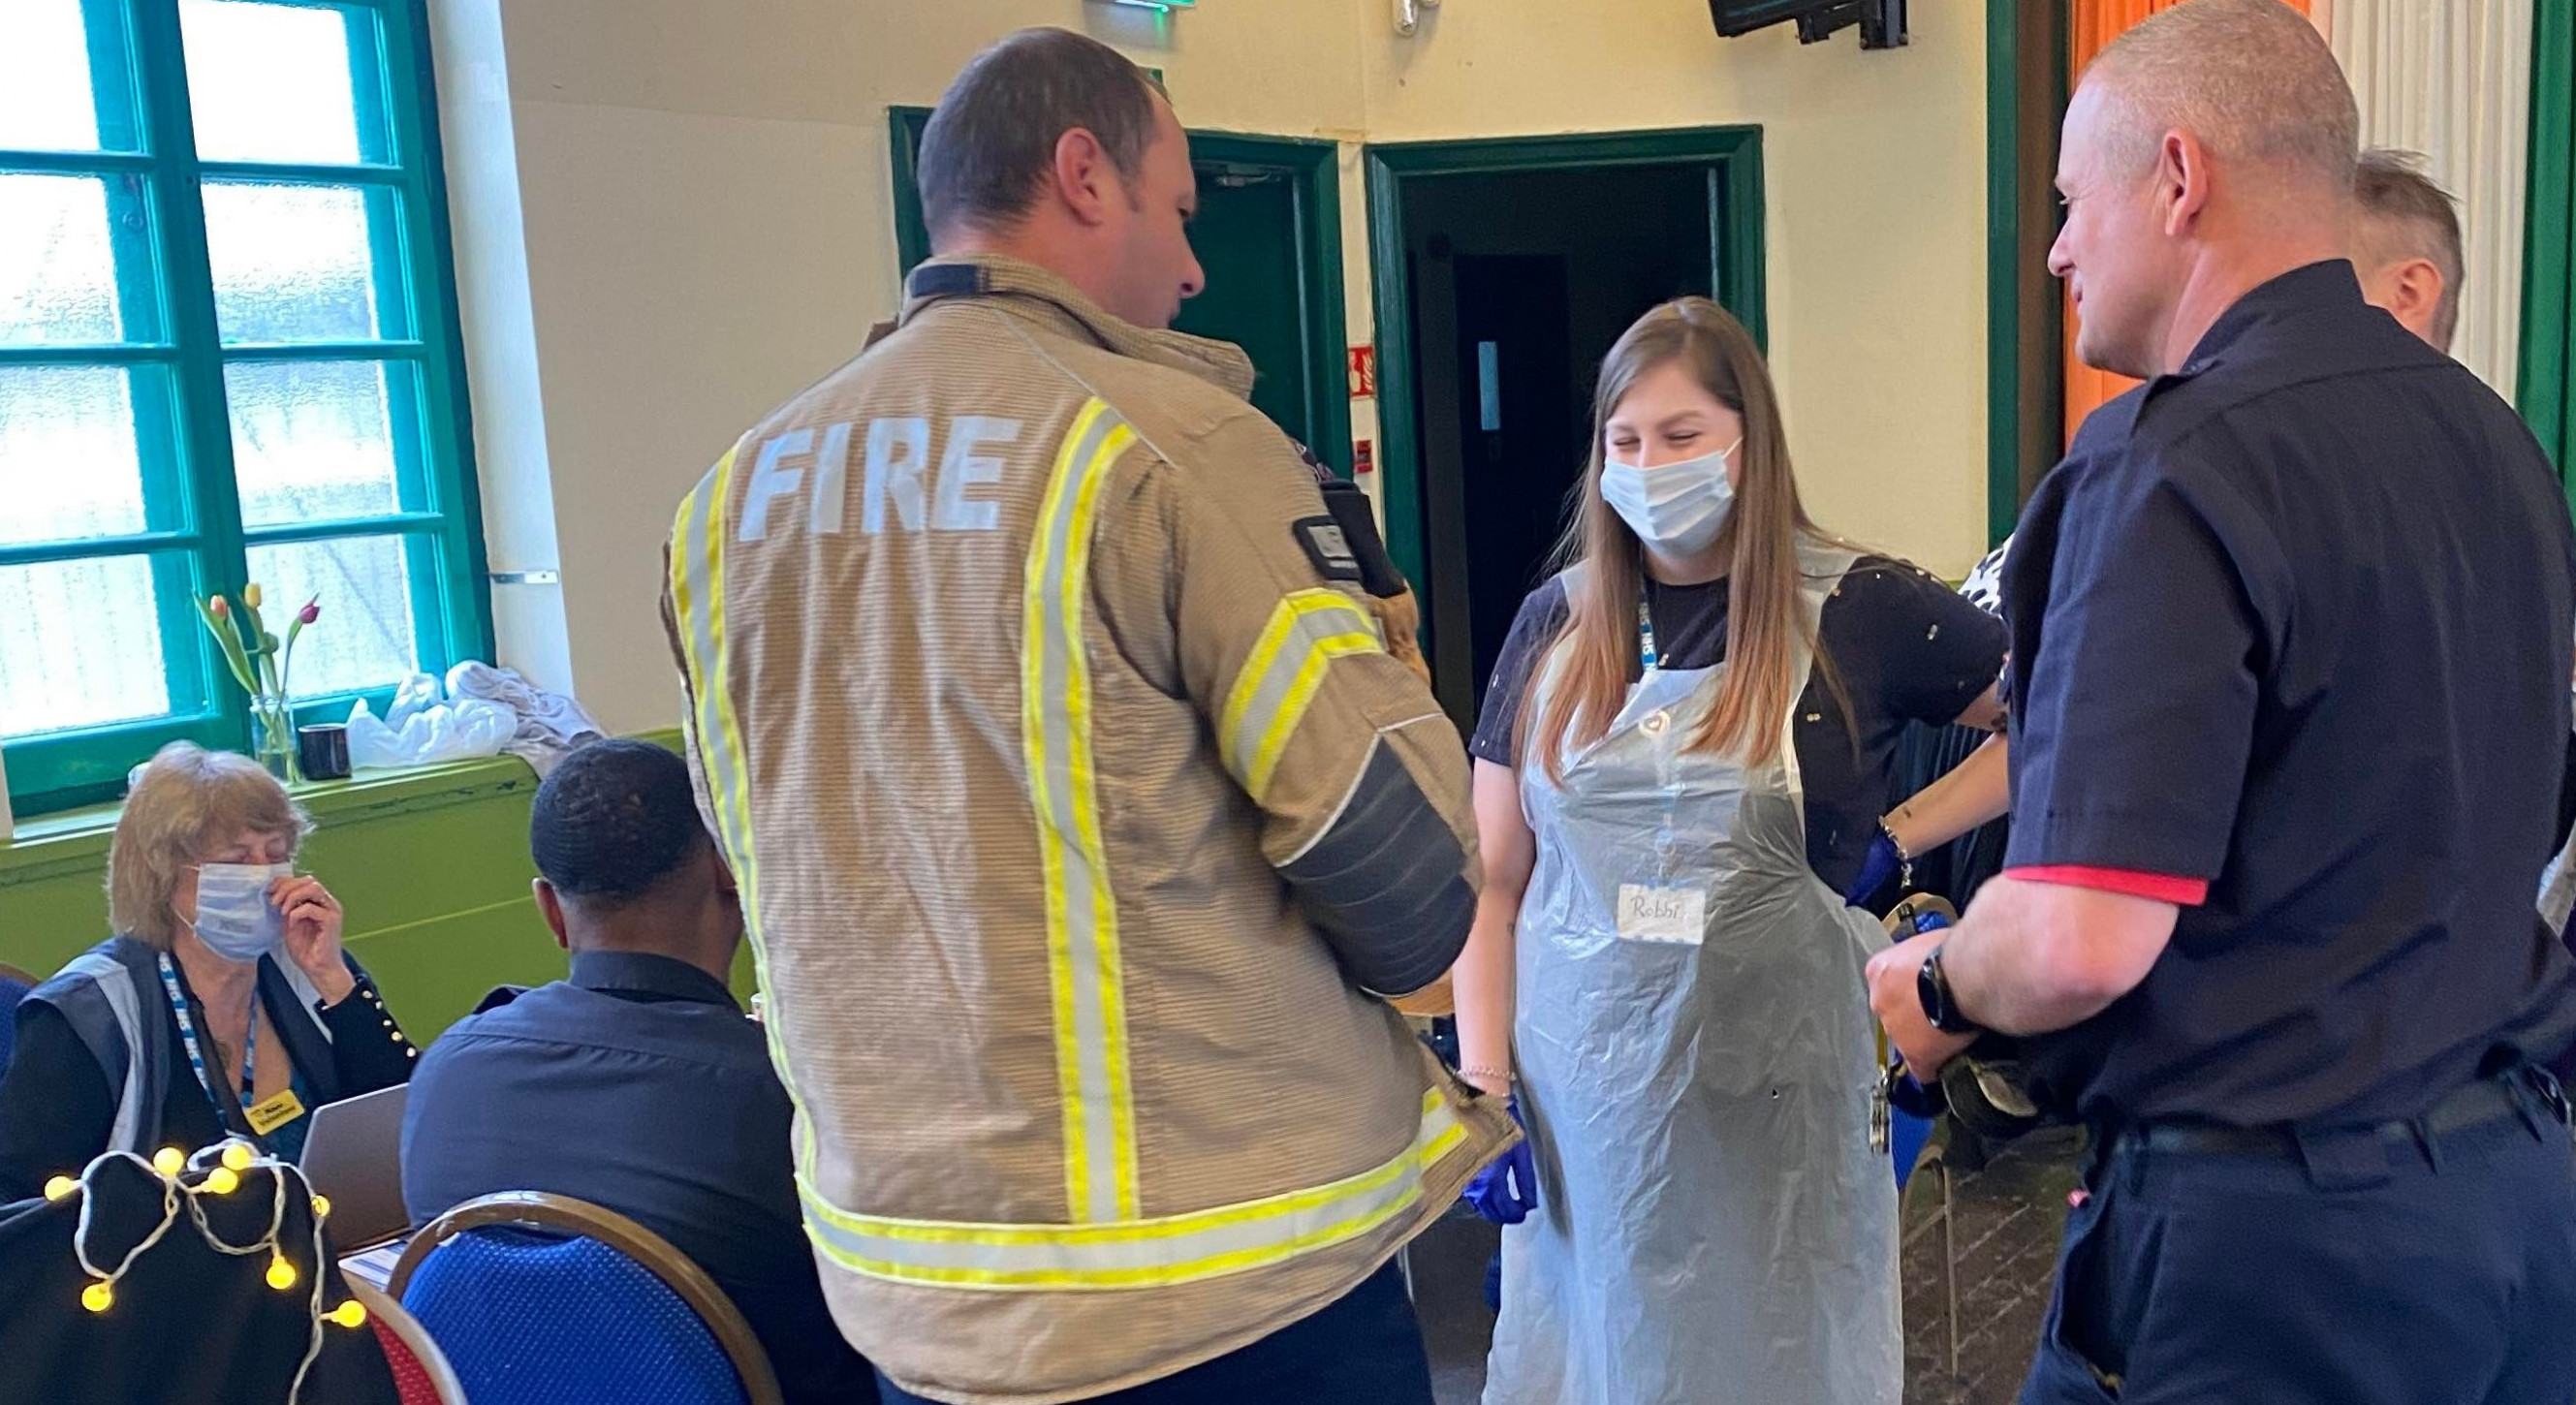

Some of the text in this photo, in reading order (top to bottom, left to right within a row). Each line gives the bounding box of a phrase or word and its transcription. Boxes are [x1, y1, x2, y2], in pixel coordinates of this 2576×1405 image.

[738, 415, 1023, 542] FIRE
[1642, 633, 1654, 655] NHS
[1630, 895, 1681, 919] Robbi
